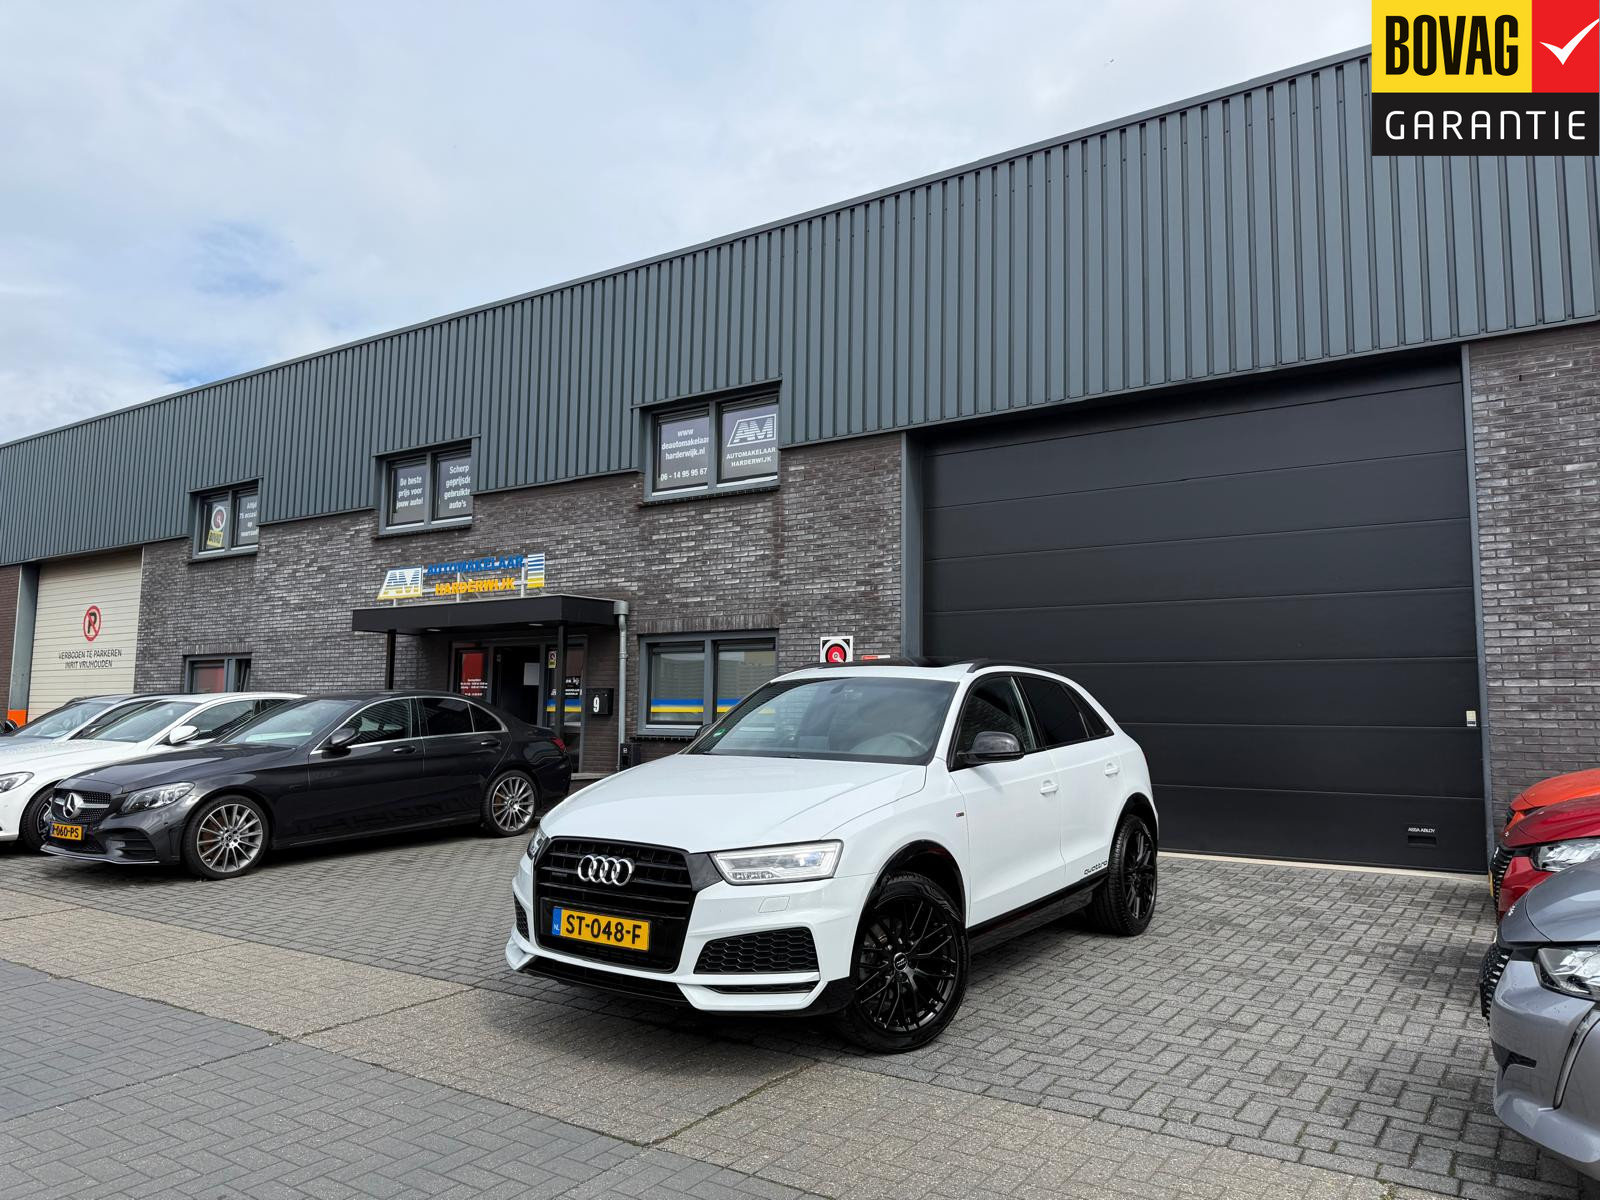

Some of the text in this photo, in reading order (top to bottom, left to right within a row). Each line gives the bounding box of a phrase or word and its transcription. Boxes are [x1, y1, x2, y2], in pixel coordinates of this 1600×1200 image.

[677, 428, 694, 438] www
[665, 447, 706, 460] harderwijk.nl
[726, 446, 776, 460] AUTOMAKELAAR
[731, 456, 771, 467] HARDERWIJK
[449, 464, 470, 474] Scherp
[673, 471, 681, 479] 14
[681, 470, 690, 478] 95
[690, 468, 699, 477] 95
[407, 476, 422, 485] beste
[398, 487, 423, 499] prijs voor
[396, 500, 409, 509] jouw
[448, 499, 467, 509] auto's
[425, 554, 524, 576] AUTOMAKELAAR
[435, 577, 515, 596] HARDERWIJK
[86, 649, 93, 658] TE
[93, 648, 122, 658] PARKEREN
[593, 696, 600, 713] 9
[566, 914, 642, 944] ST-048-F
